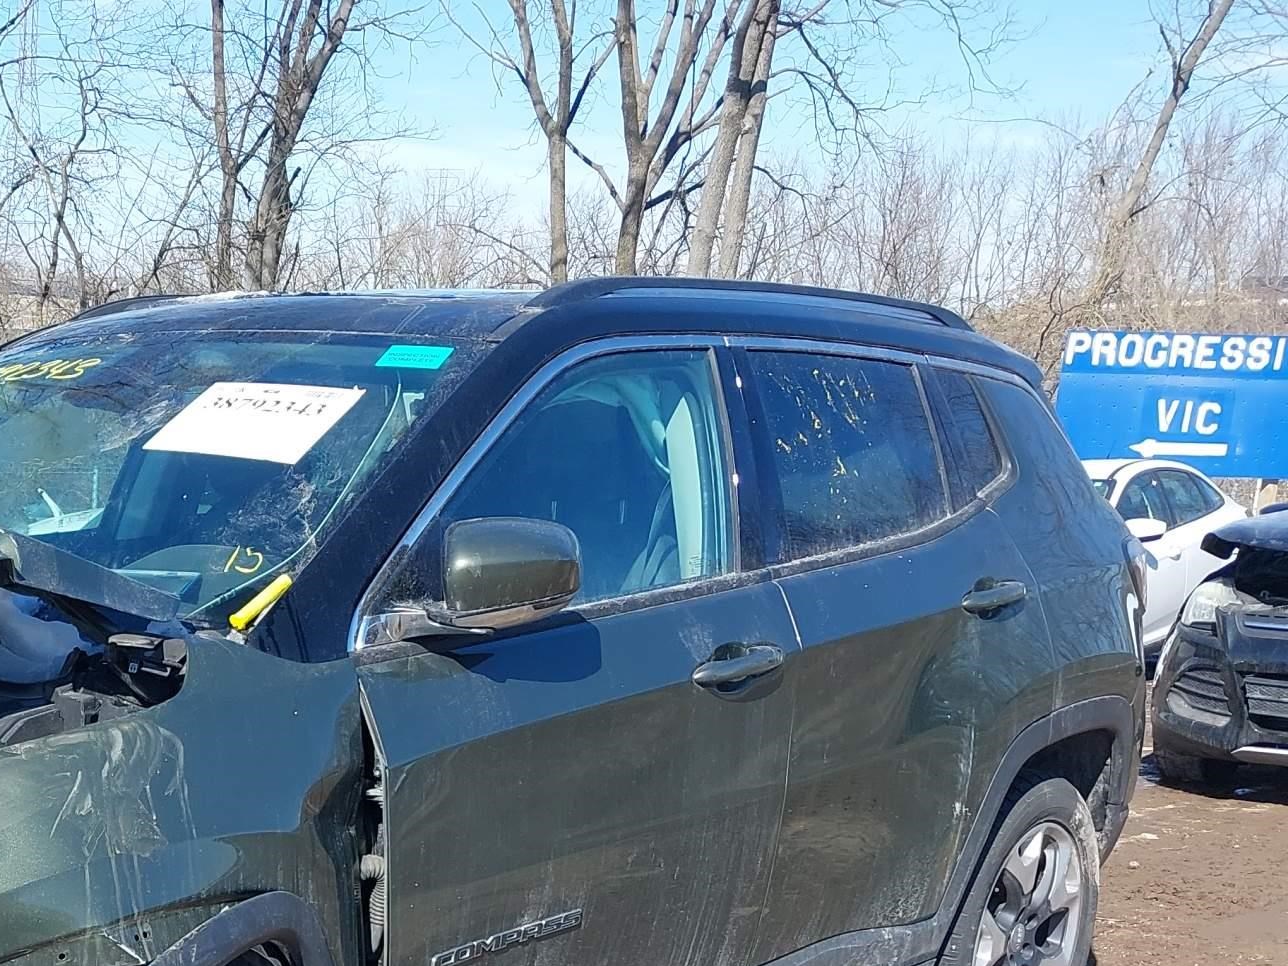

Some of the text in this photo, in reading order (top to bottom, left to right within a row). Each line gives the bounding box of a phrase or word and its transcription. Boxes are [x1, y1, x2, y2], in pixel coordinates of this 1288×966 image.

[1065, 332, 1285, 371] PROGRESSI
[1158, 398, 1222, 435] VIC
[223, 544, 264, 574] 15
